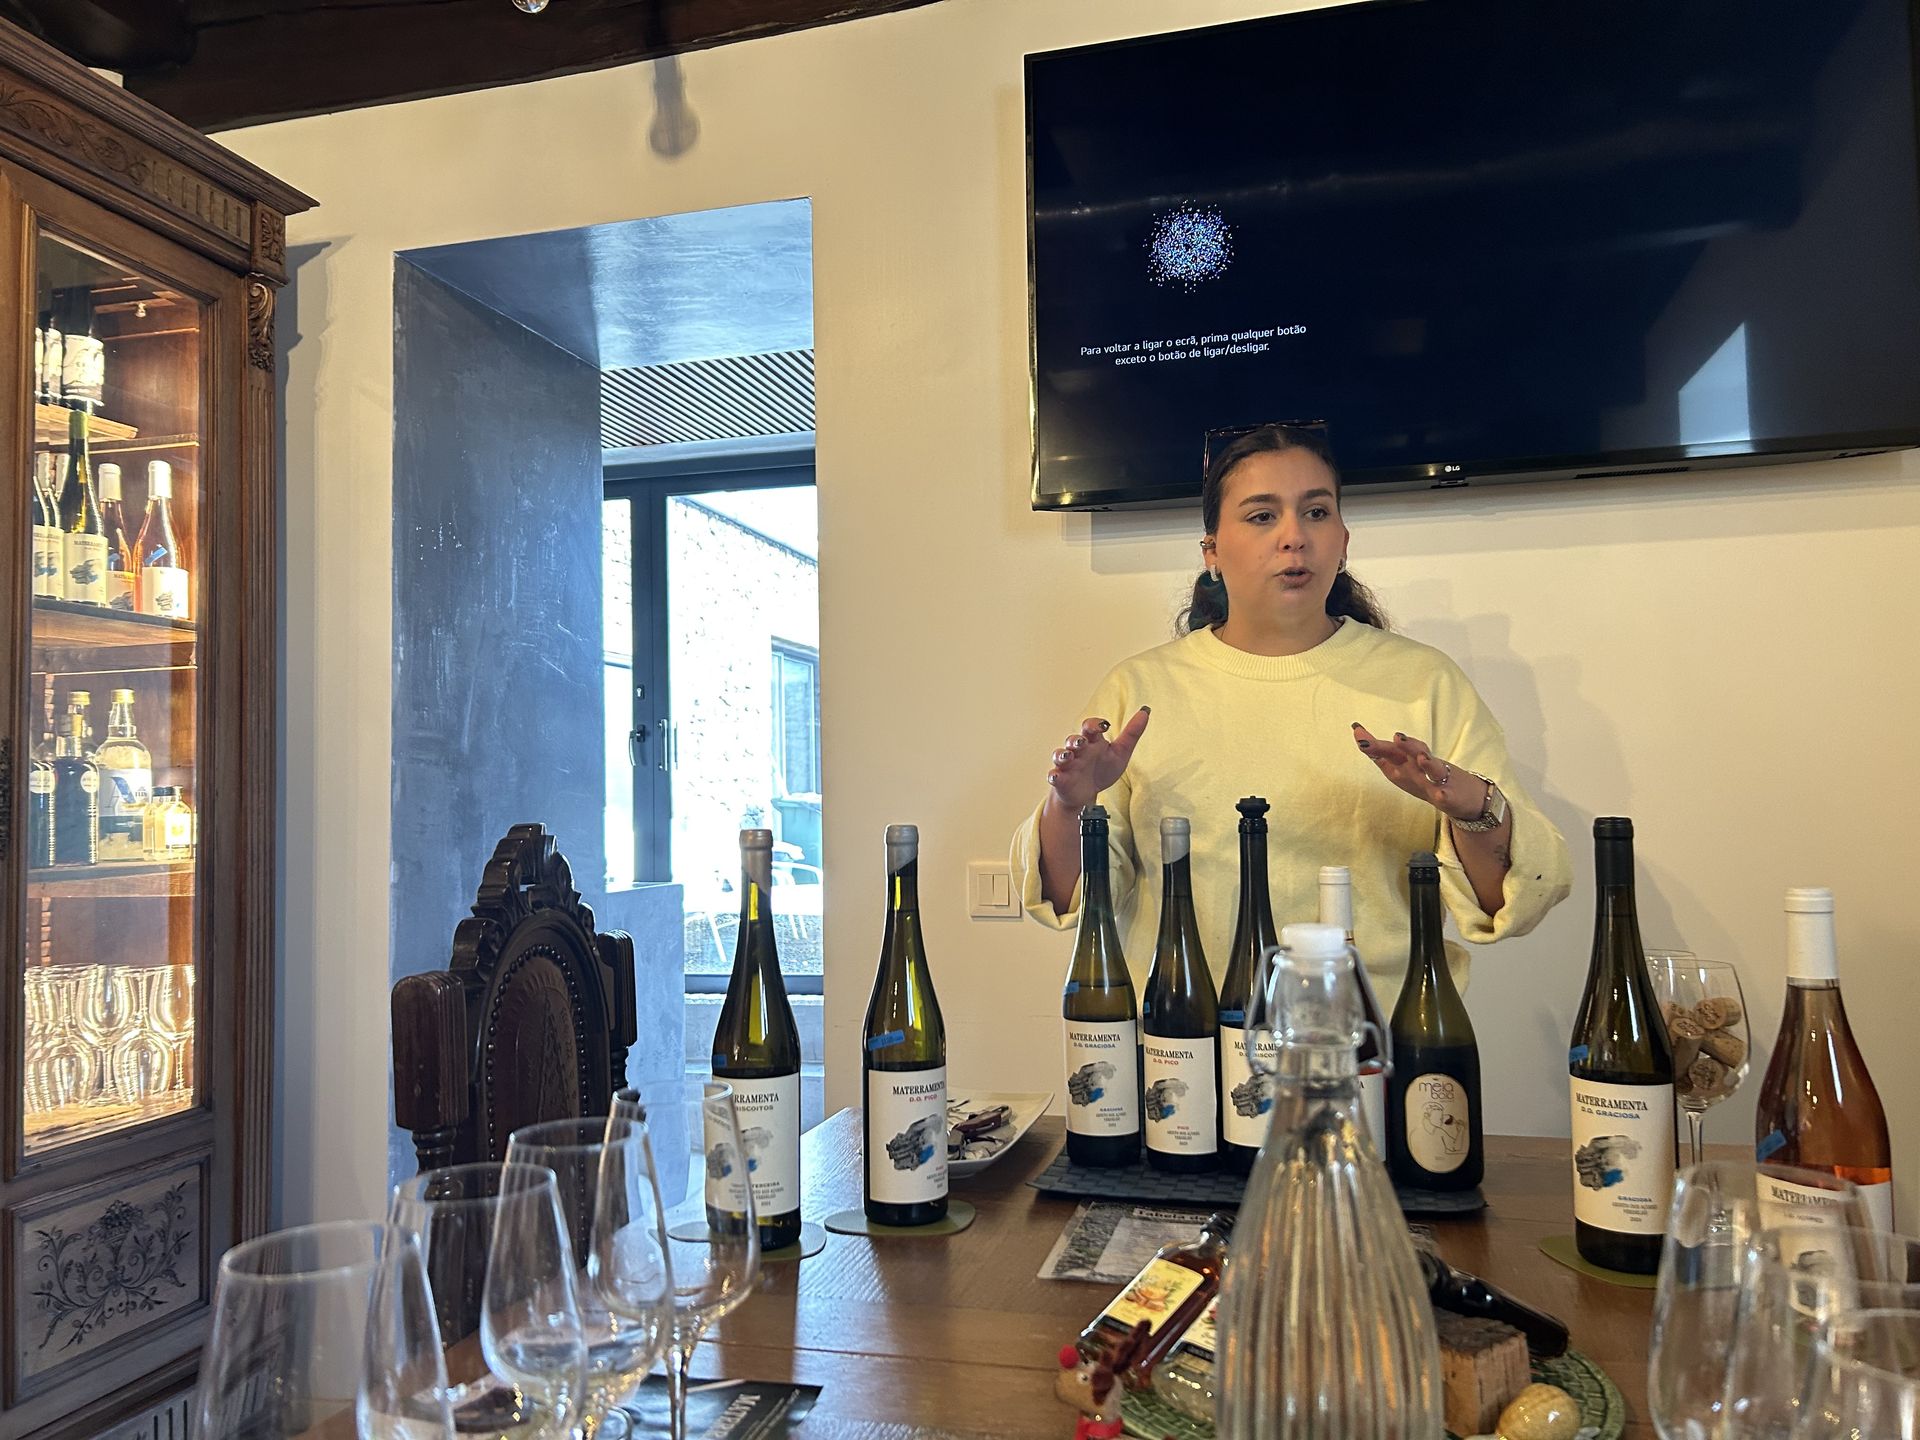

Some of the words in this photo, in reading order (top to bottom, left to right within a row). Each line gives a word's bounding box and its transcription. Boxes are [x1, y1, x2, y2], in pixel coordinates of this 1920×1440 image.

[1080, 347, 1101, 356] Para
[1104, 343, 1131, 354] voltar
[1142, 340, 1164, 351] ligar
[1175, 335, 1198, 346] ecrã,
[1201, 333, 1229, 346] prima
[1231, 329, 1275, 342] qualquer
[1277, 325, 1307, 336] botão
[1115, 355, 1147, 365] exceto
[1158, 350, 1186, 361] botão
[1189, 348, 1201, 358] de
[1203, 342, 1270, 358] ligar/desligar.
[1069, 1031, 1121, 1042] MATERRAMENTA
[1145, 1046, 1194, 1059] MATERRAMENTA
[734, 1092, 779, 1104] RRAMENTA
[1575, 1092, 1648, 1111] MATERRAMENTA
[1595, 1109, 1641, 1119] GRACIOSA
